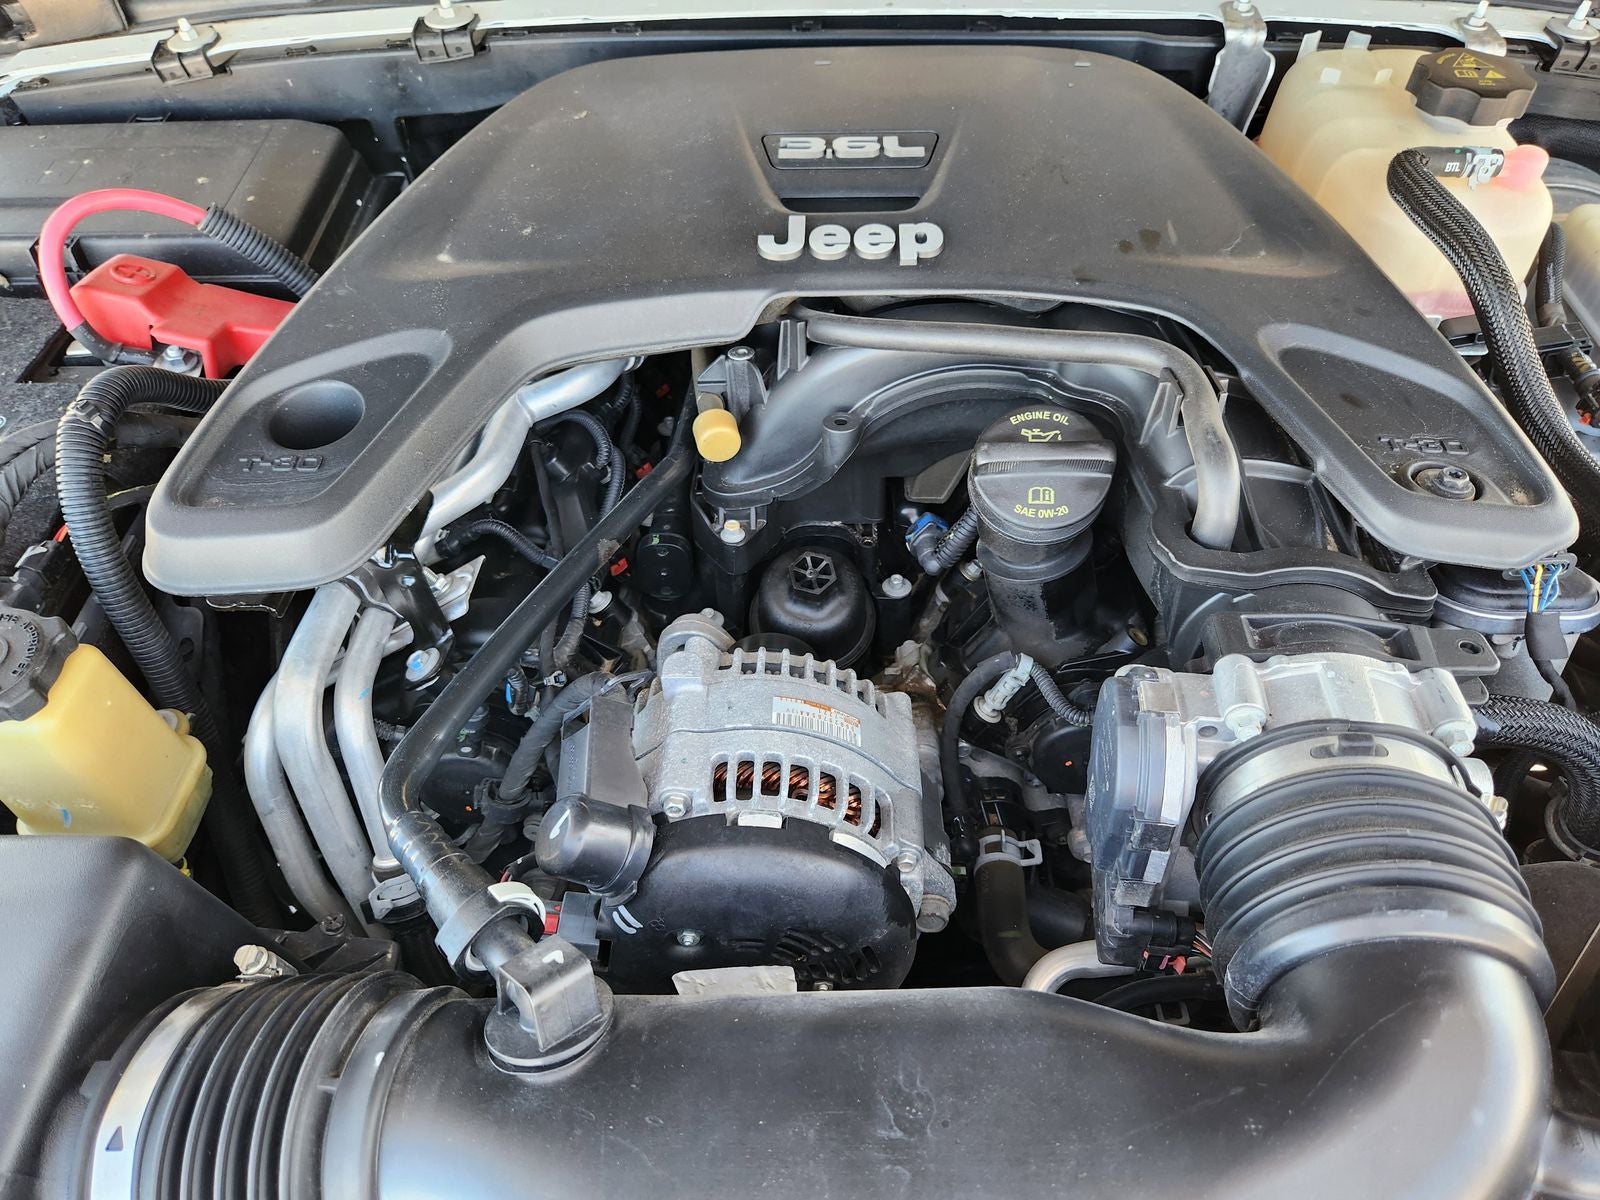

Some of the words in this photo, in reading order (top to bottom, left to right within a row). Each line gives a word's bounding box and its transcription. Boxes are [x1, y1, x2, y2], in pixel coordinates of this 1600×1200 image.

[778, 136, 926, 159] 3.6L
[757, 215, 944, 266] Jeep
[1009, 411, 1051, 425] ENGINE
[1052, 412, 1071, 426] OIL
[239, 455, 324, 472] T-30
[1014, 504, 1036, 518] SAE
[1038, 505, 1069, 519] 0W-20
